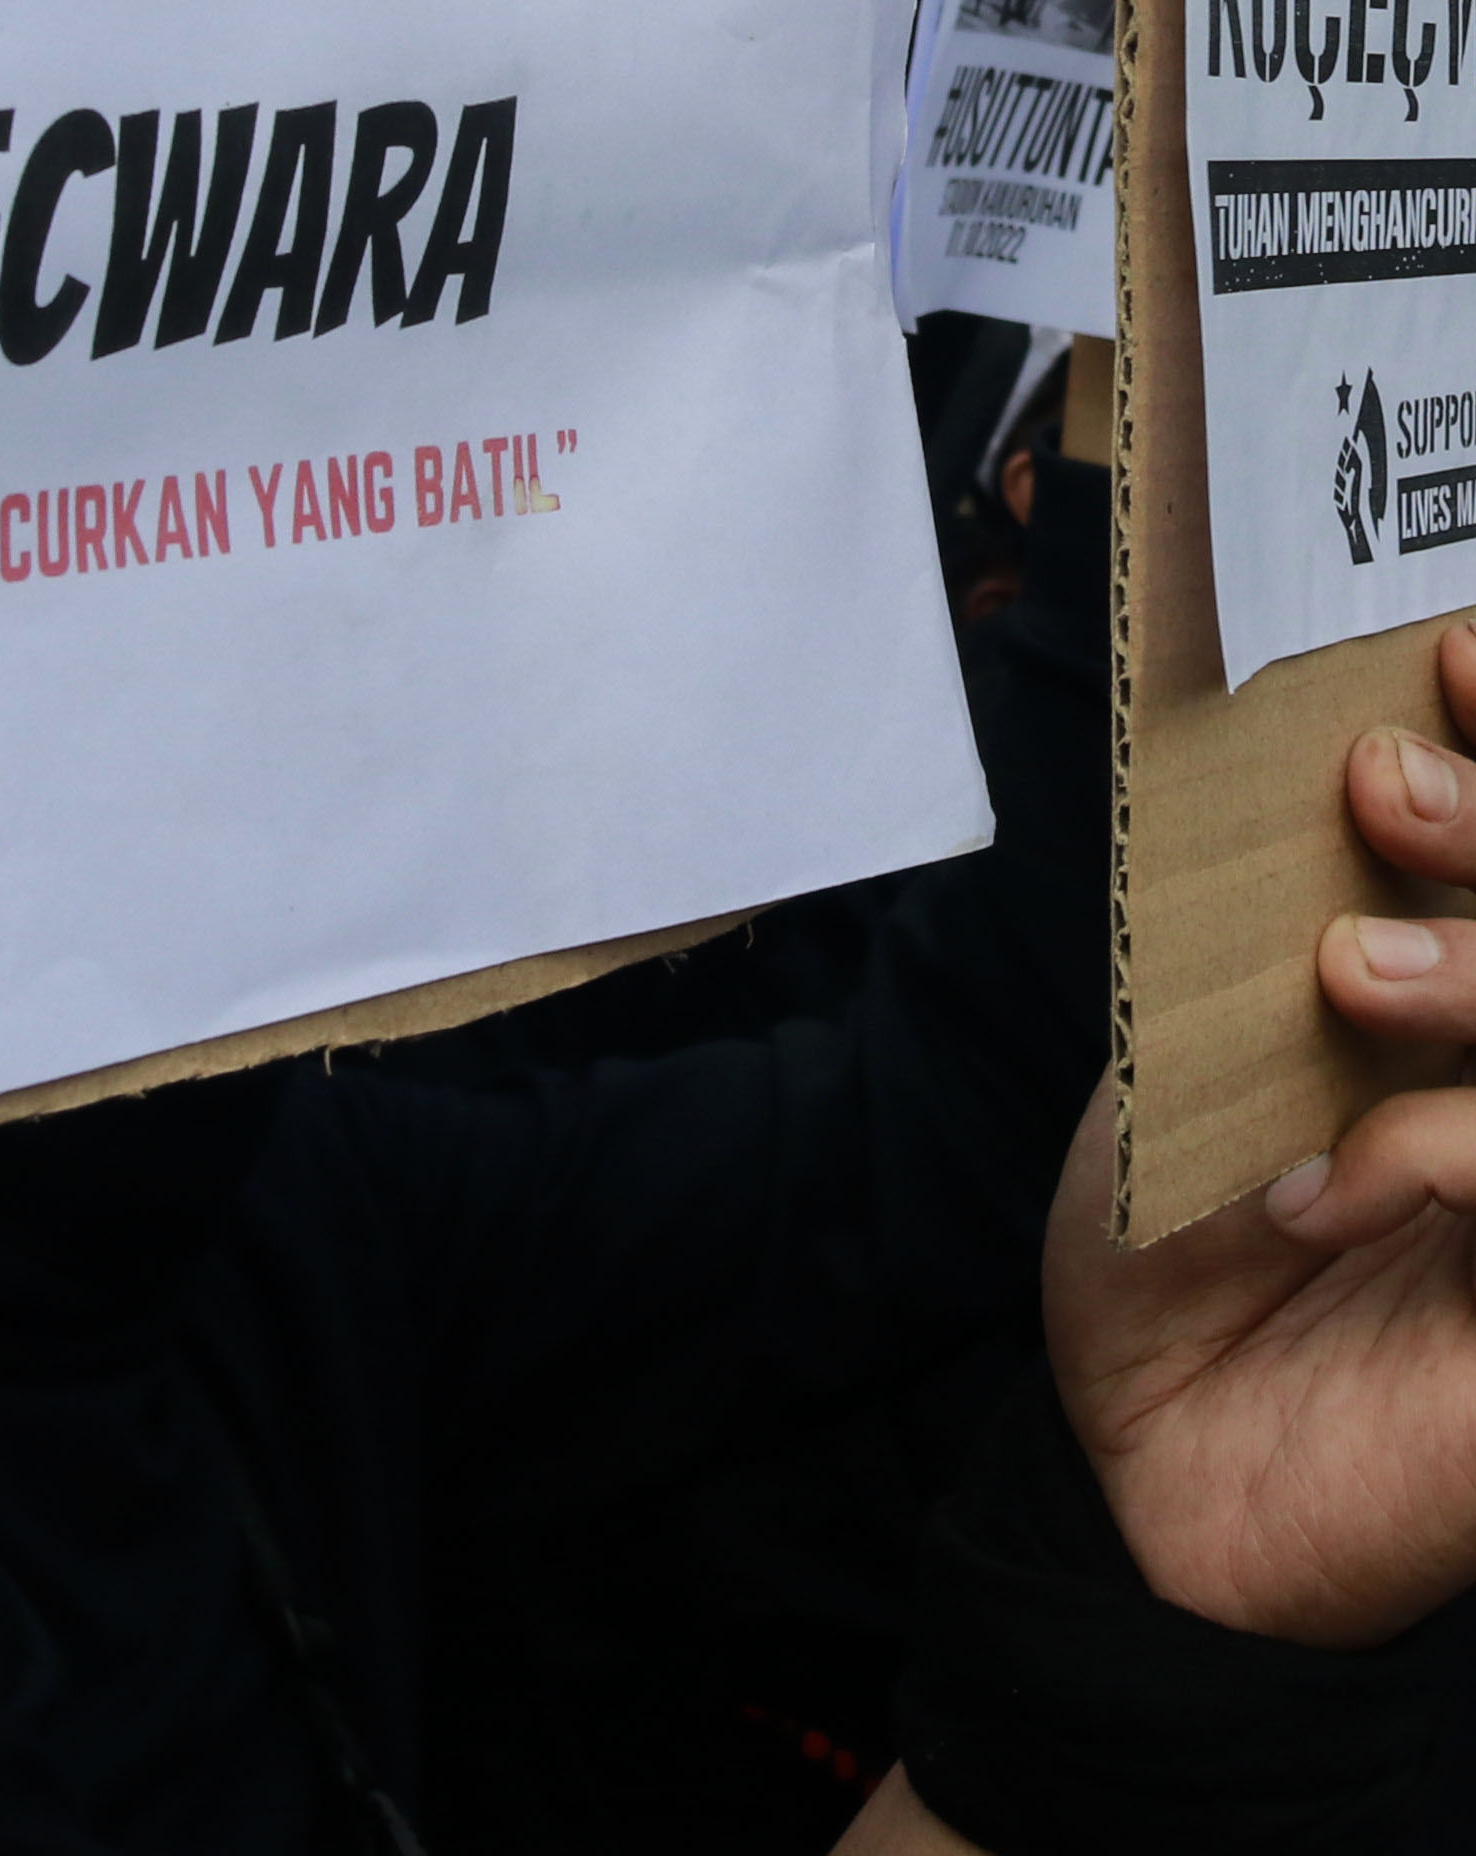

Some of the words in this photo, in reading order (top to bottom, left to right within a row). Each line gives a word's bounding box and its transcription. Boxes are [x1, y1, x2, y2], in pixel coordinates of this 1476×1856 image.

[1214, 191, 1290, 261] TUHAN
[247, 449, 396, 549] YANG
[1400, 484, 1453, 542] LIVES
